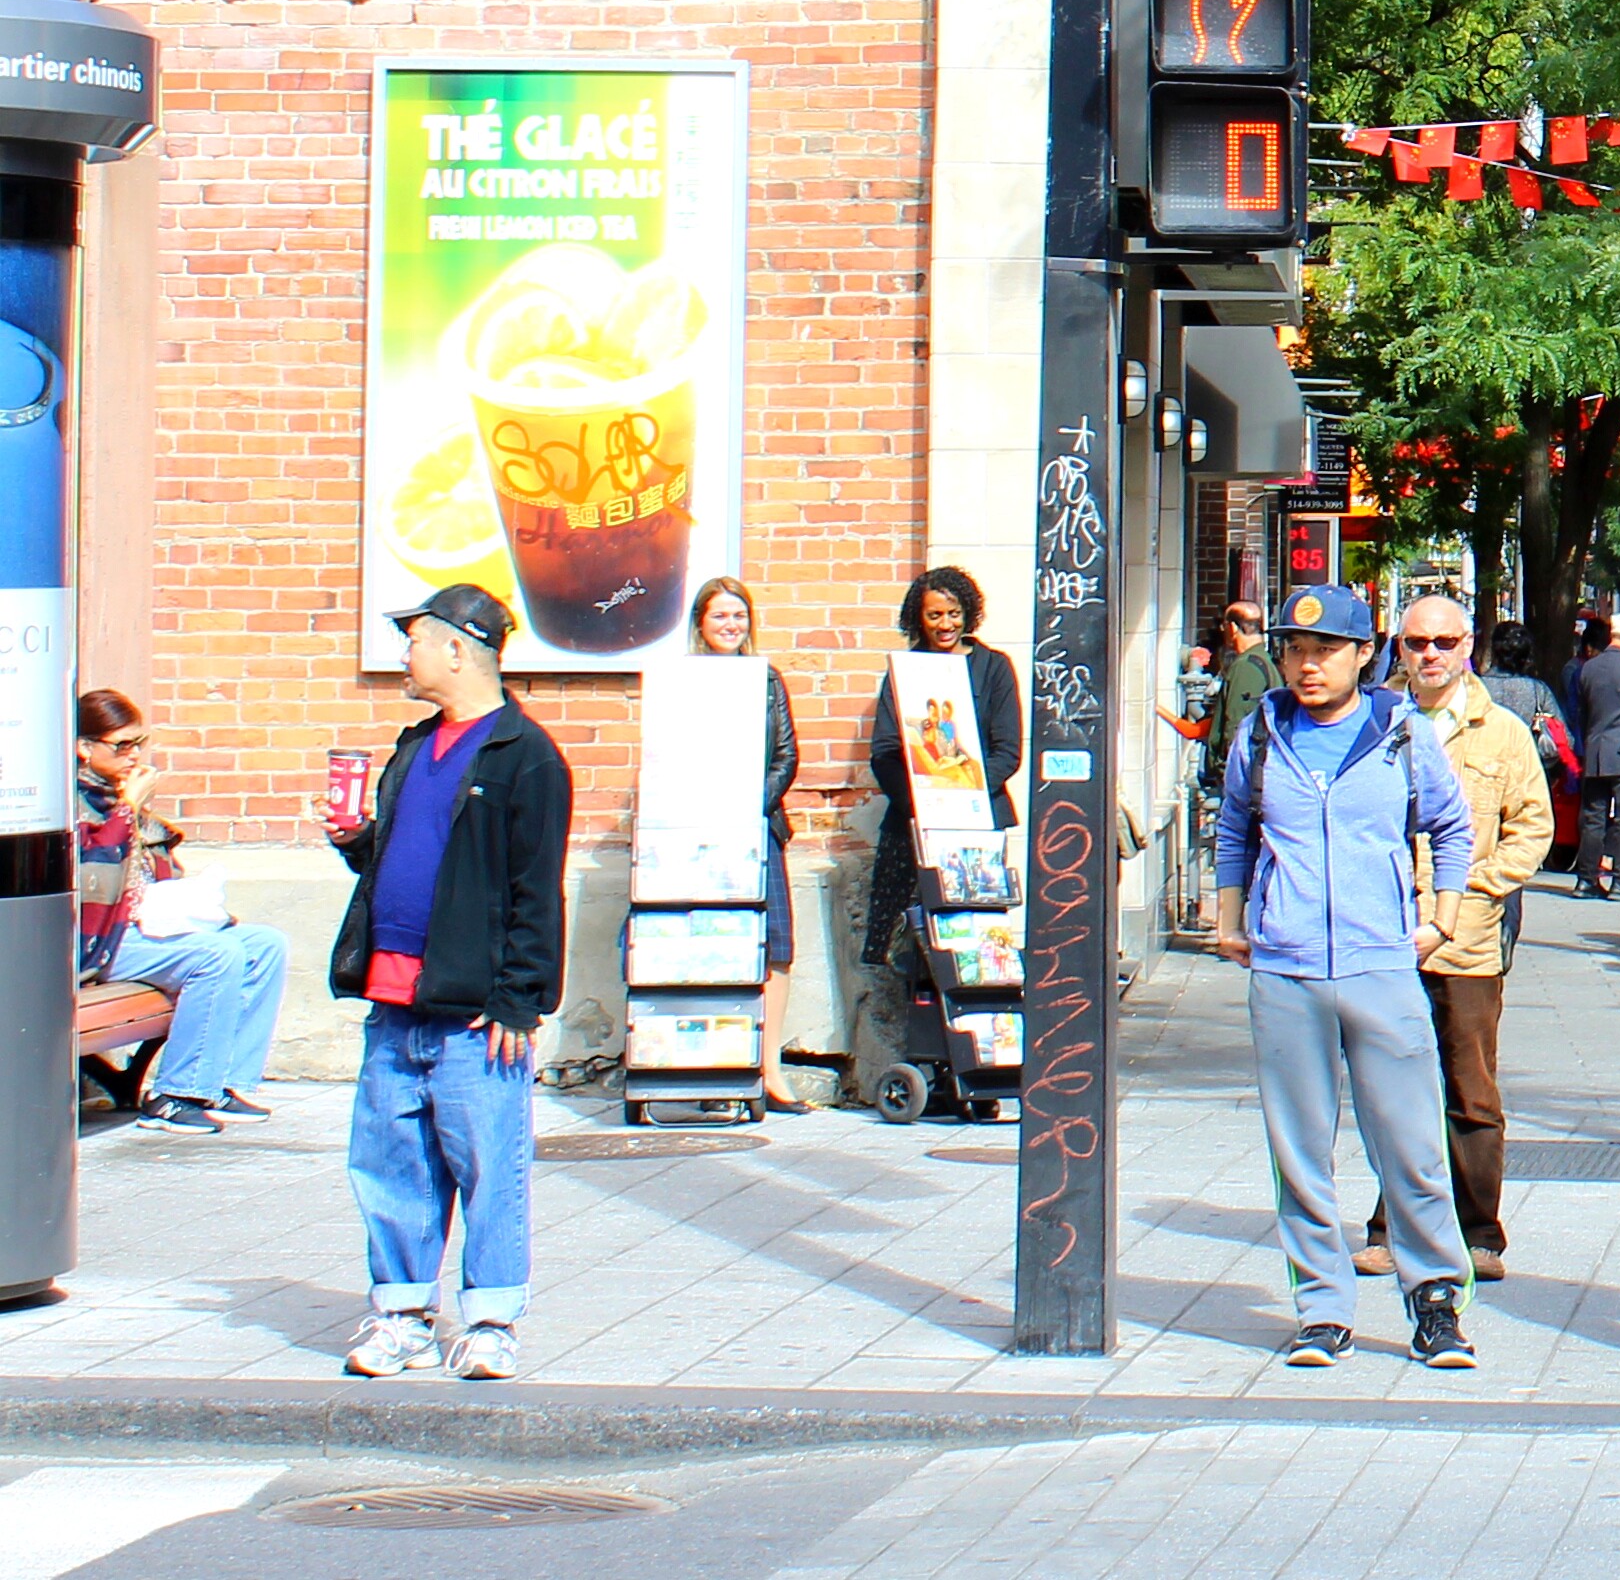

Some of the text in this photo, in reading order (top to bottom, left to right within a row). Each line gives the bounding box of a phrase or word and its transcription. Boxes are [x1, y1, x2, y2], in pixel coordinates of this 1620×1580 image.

[75, 57, 143, 93] chinois
[421, 99, 657, 161] THÉ GLACÉ
[420, 168, 662, 199] AU CITRON FRAIS
[485, 215, 554, 240] LEMON
[556, 215, 598, 240] ICED
[600, 215, 638, 240] TEA
